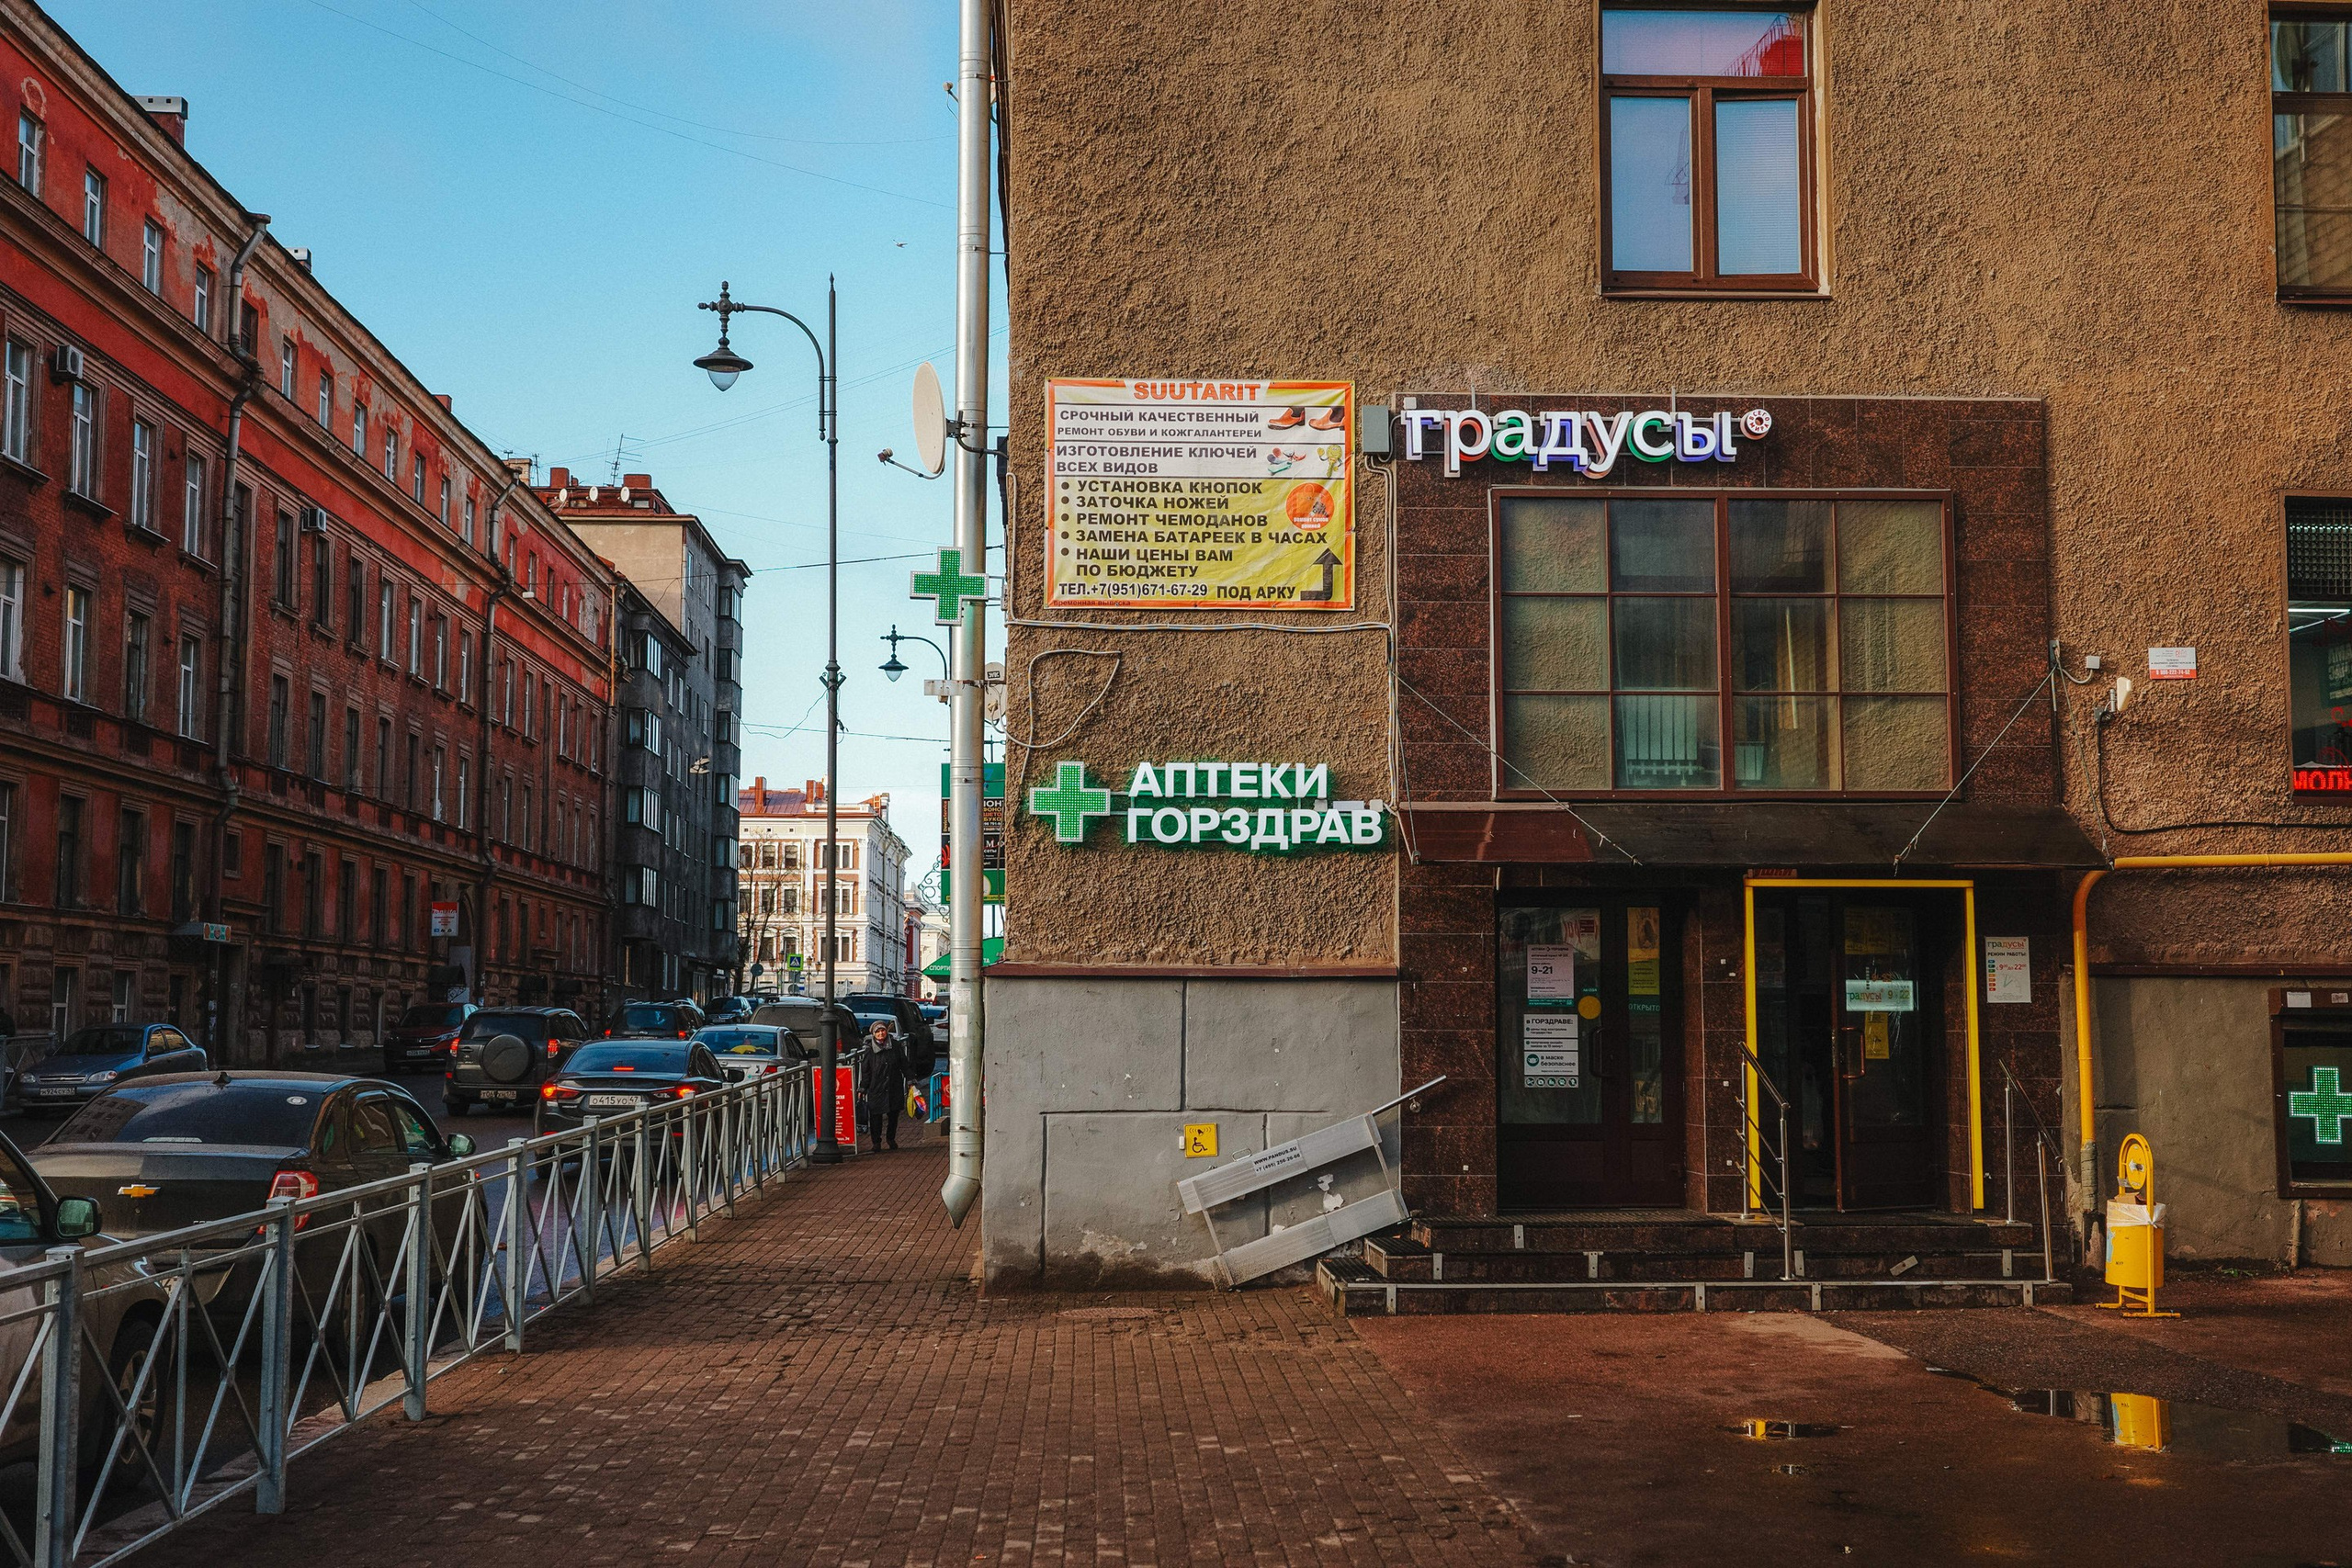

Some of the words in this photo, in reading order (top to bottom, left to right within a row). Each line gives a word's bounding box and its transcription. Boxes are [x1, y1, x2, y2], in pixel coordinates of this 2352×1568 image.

[1134, 382, 1261, 400] SUUTARIT
[1060, 410, 1134, 422] СРОЧНЫЙ
[1138, 411, 1259, 423] КАЧЕСТВЕННЫЙ
[1749, 411, 1770, 421] ВСЕГО
[1057, 427, 1104, 436] РЕМОНТ
[1107, 427, 1146, 436] ОБУВИ
[1149, 428, 1158, 436] И
[1160, 428, 1261, 438] КОЖГАЛАНТЕРЕИ
[1749, 422, 1770, 432] МИРА
[1057, 446, 1183, 457] ИЗГОТОВЛЕНИЕ
[1189, 445, 1257, 458] КЛЮЧЕЙ
[1401, 410, 1736, 479] градусы
[1057, 462, 1098, 473] ВСЕХ
[1103, 463, 1158, 474] ВИДОВ
[1078, 480, 1183, 493] УСТАНОВКА
[1189, 481, 1262, 494] КНОПОК
[1076, 496, 1157, 508] ЗАТОЧКА
[1163, 496, 1229, 509] НОЖЕЙ
[1077, 513, 1149, 525] РЕМОНТ
[1156, 514, 1268, 528] ЧЕМОДАНОВ
[1076, 530, 1148, 542] ЗАМЕНА
[1154, 531, 1245, 543] БАТАРЕЕК
[1251, 532, 1262, 543] В
[1270, 532, 1328, 544] ЧАСАХ
[1077, 548, 1130, 560] НАШИ
[1136, 549, 1191, 562] ЦЕНЫ
[1195, 550, 1233, 561] ВАМ
[1076, 564, 1102, 577] ПО
[1107, 565, 1199, 579] БЮДЖЕТУ
[1217, 585, 1251, 601] ПОД
[1256, 586, 1295, 599] АРКУ
[1128, 761, 1328, 798] АПТЕКИ
[1127, 808, 1383, 850] ГОРЗДРАВ
[1987, 941, 2025, 949] градусы
[1532, 965, 1553, 975] 9-21
[1254, 1146, 1297, 1165] WWW.PANDUS.SU
